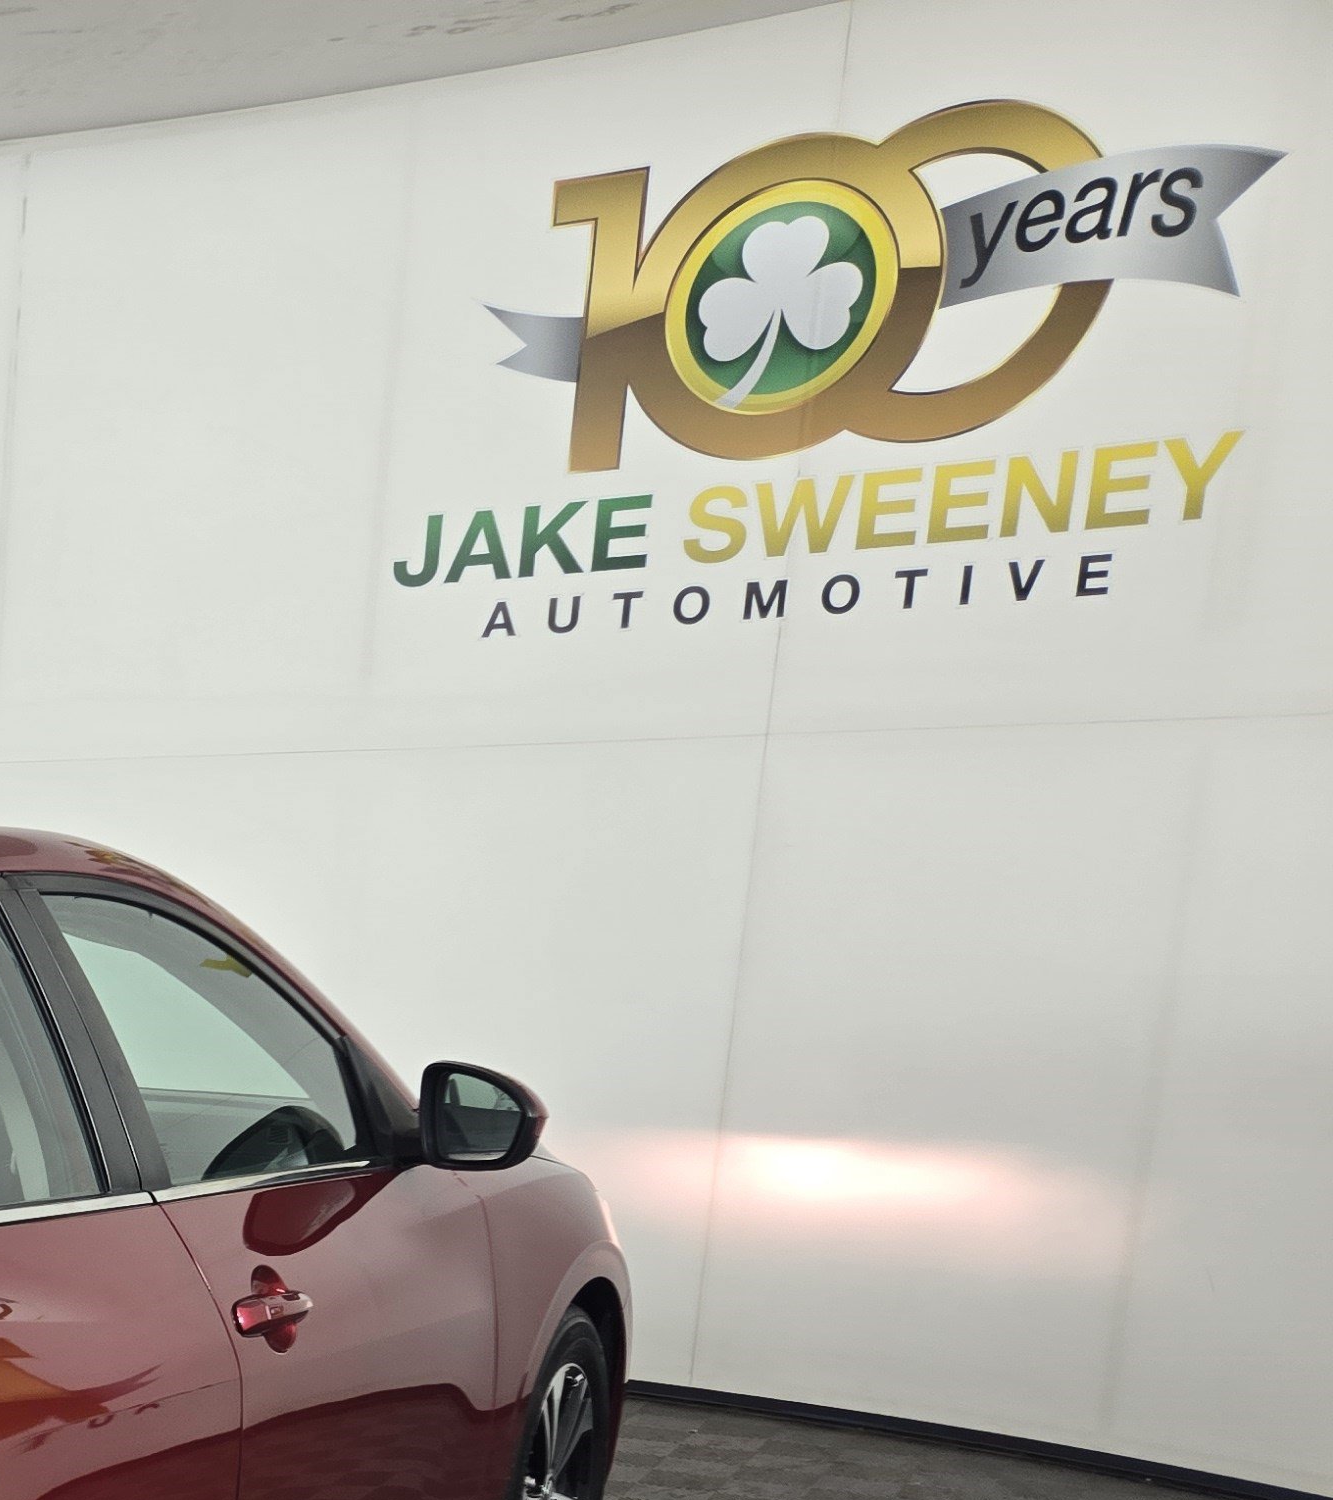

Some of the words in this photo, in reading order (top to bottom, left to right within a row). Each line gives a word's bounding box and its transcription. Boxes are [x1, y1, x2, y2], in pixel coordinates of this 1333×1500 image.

[552, 99, 1113, 473] 100
[960, 165, 1204, 289] years
[393, 494, 653, 588] JAKE
[683, 430, 1246, 564] SWEENEY
[481, 552, 1114, 639] AUTOMOTIVE
